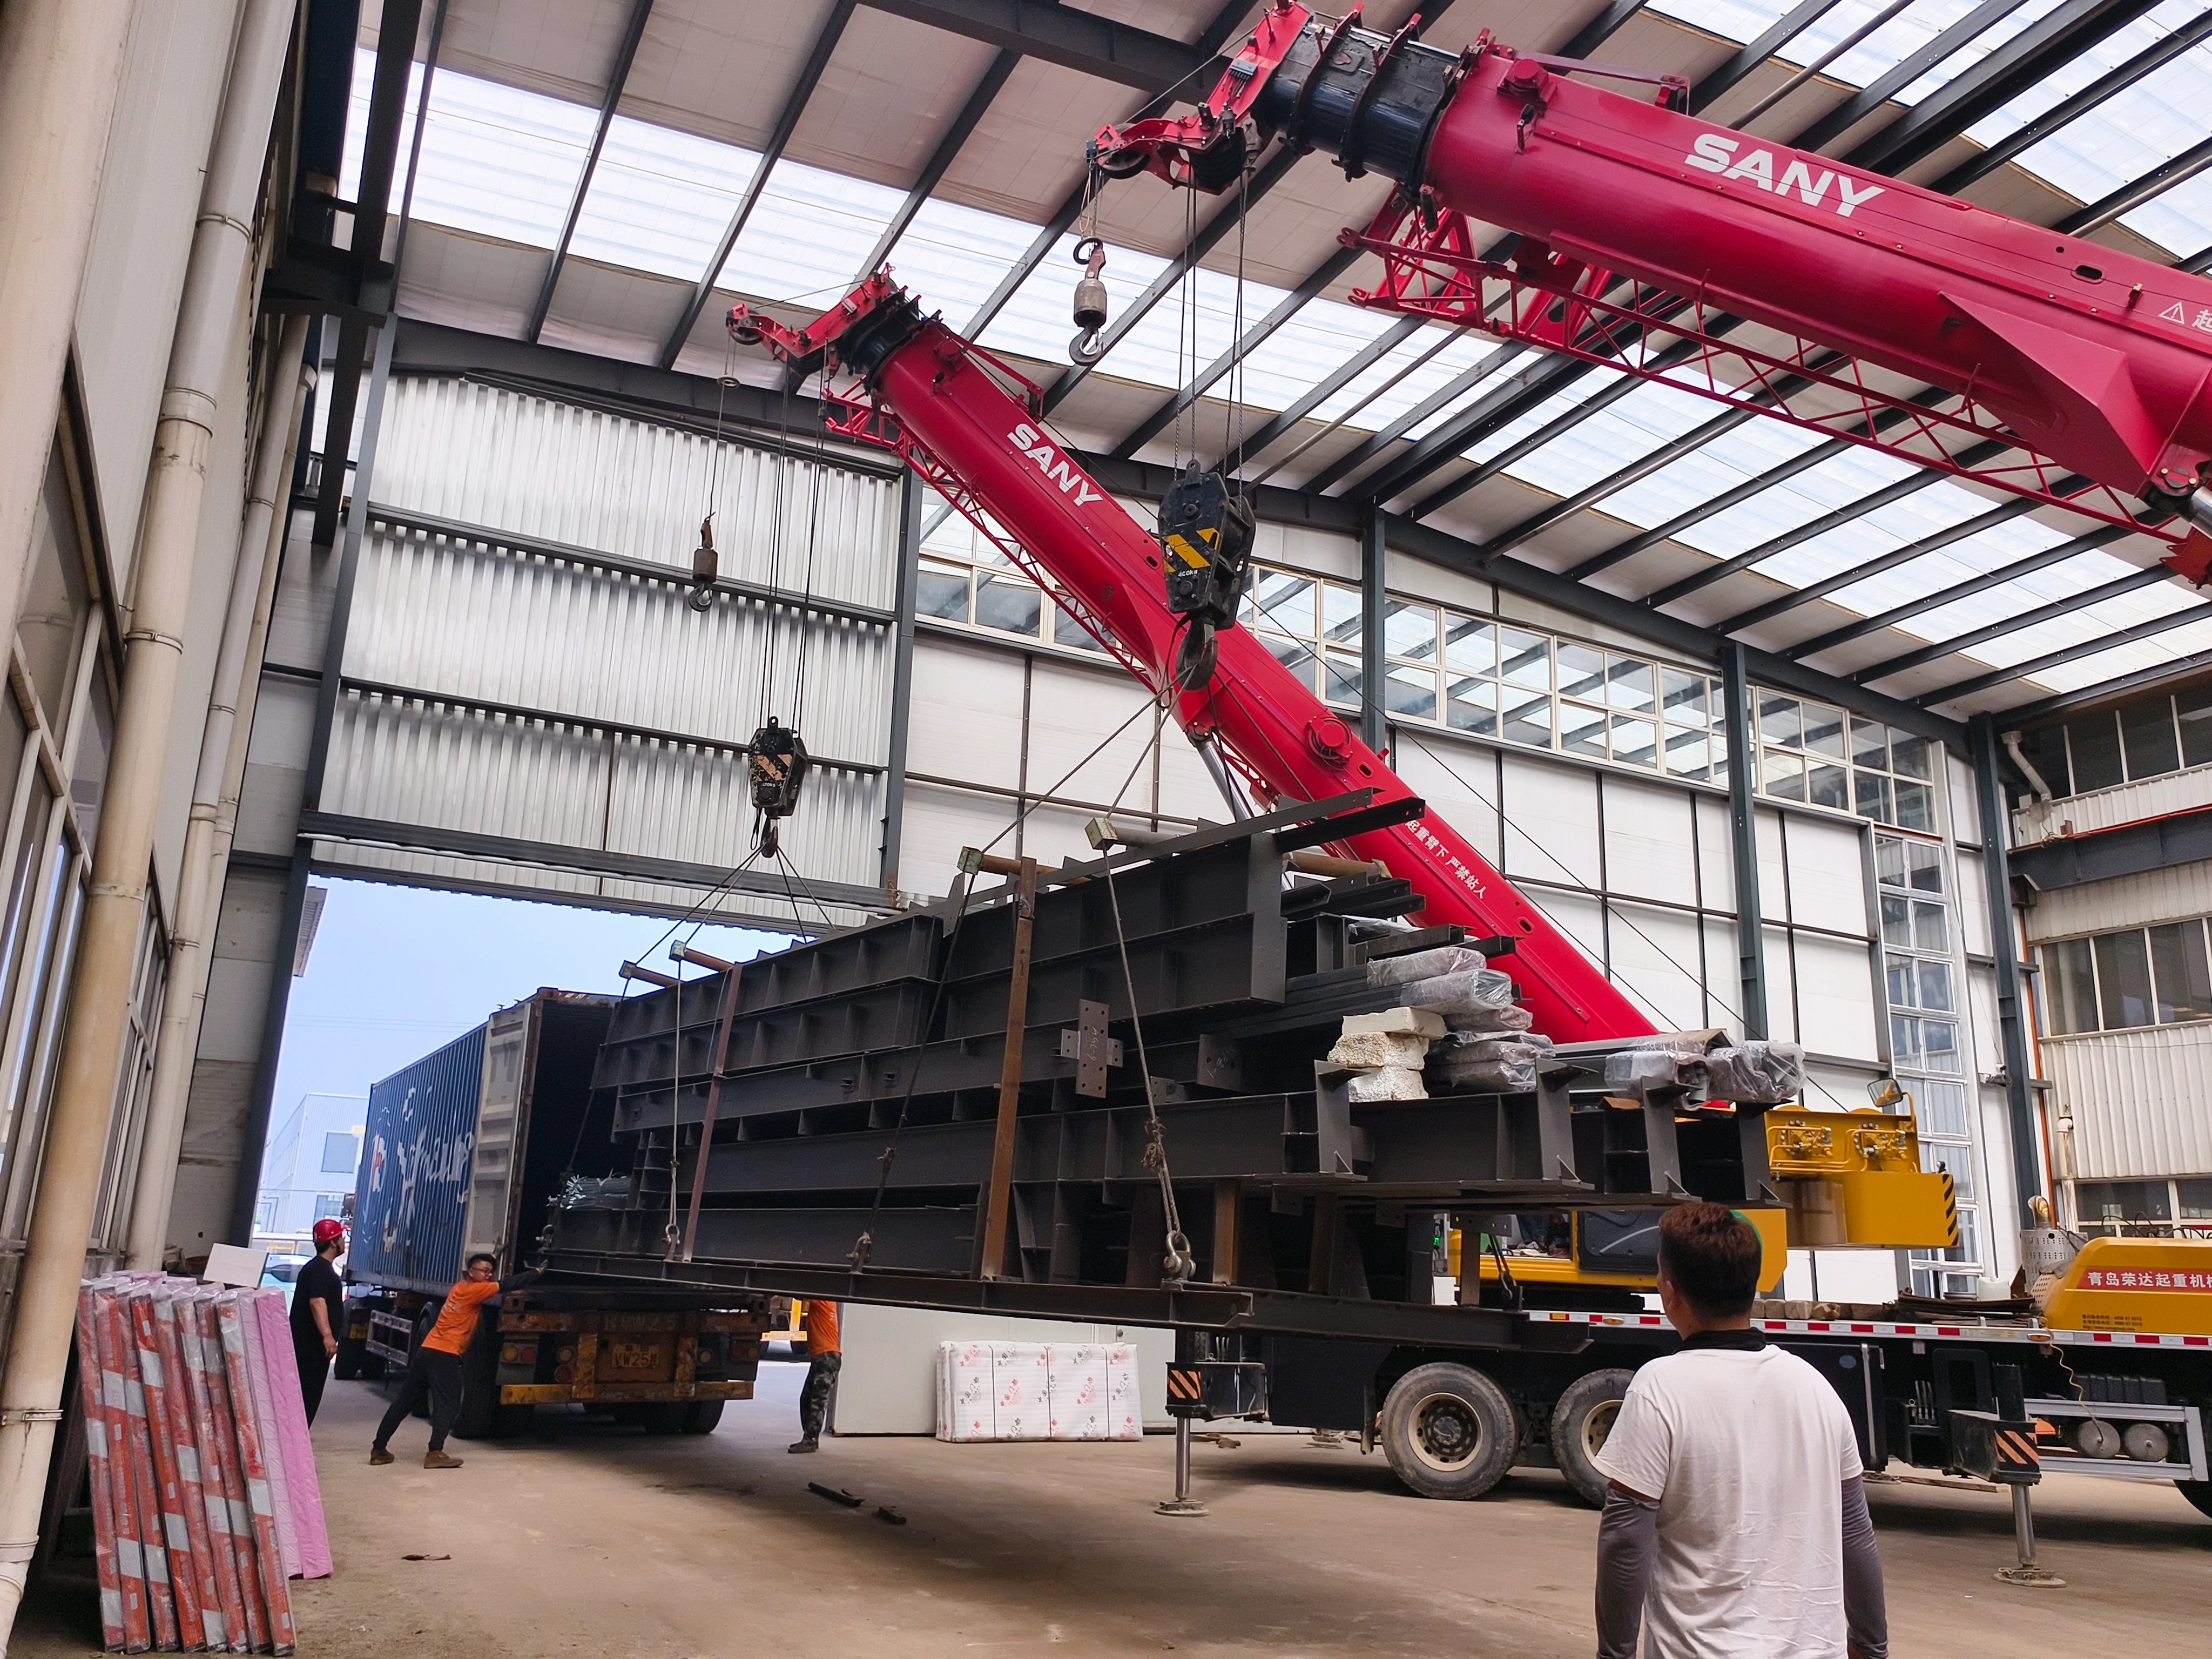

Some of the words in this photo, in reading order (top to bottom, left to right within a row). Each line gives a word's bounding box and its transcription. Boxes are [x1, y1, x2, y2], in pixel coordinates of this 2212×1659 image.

[1684, 133, 1885, 217] SANY
[1007, 423, 1103, 507] SANY
[1445, 856, 1486, 899] 严禁站人
